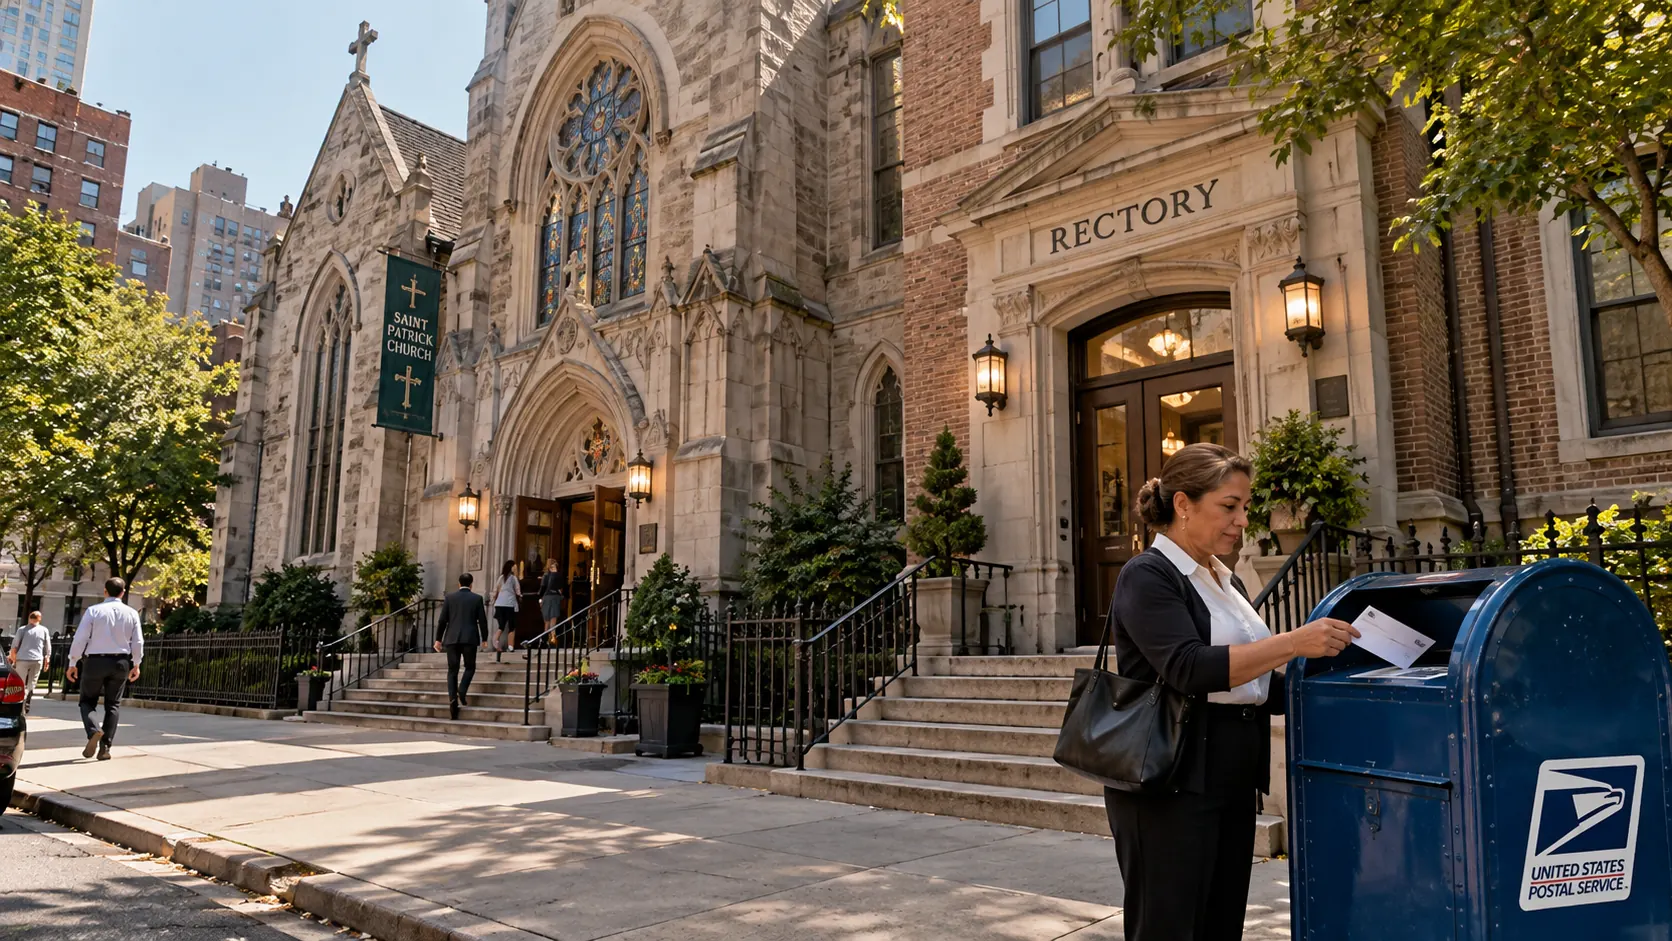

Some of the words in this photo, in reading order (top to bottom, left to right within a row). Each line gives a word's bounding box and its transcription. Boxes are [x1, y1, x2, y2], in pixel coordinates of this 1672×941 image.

[1049, 178, 1219, 255] RECTORY
[394, 312, 428, 330] SAINT
[387, 324, 434, 346] PATRICK
[387, 339, 432, 361] CHURCH
[1531, 863, 1579, 880] UNITED
[1582, 859, 1625, 875] STATES
[1528, 882, 1575, 900] POSTAL
[1577, 877, 1624, 894] SERVICE
